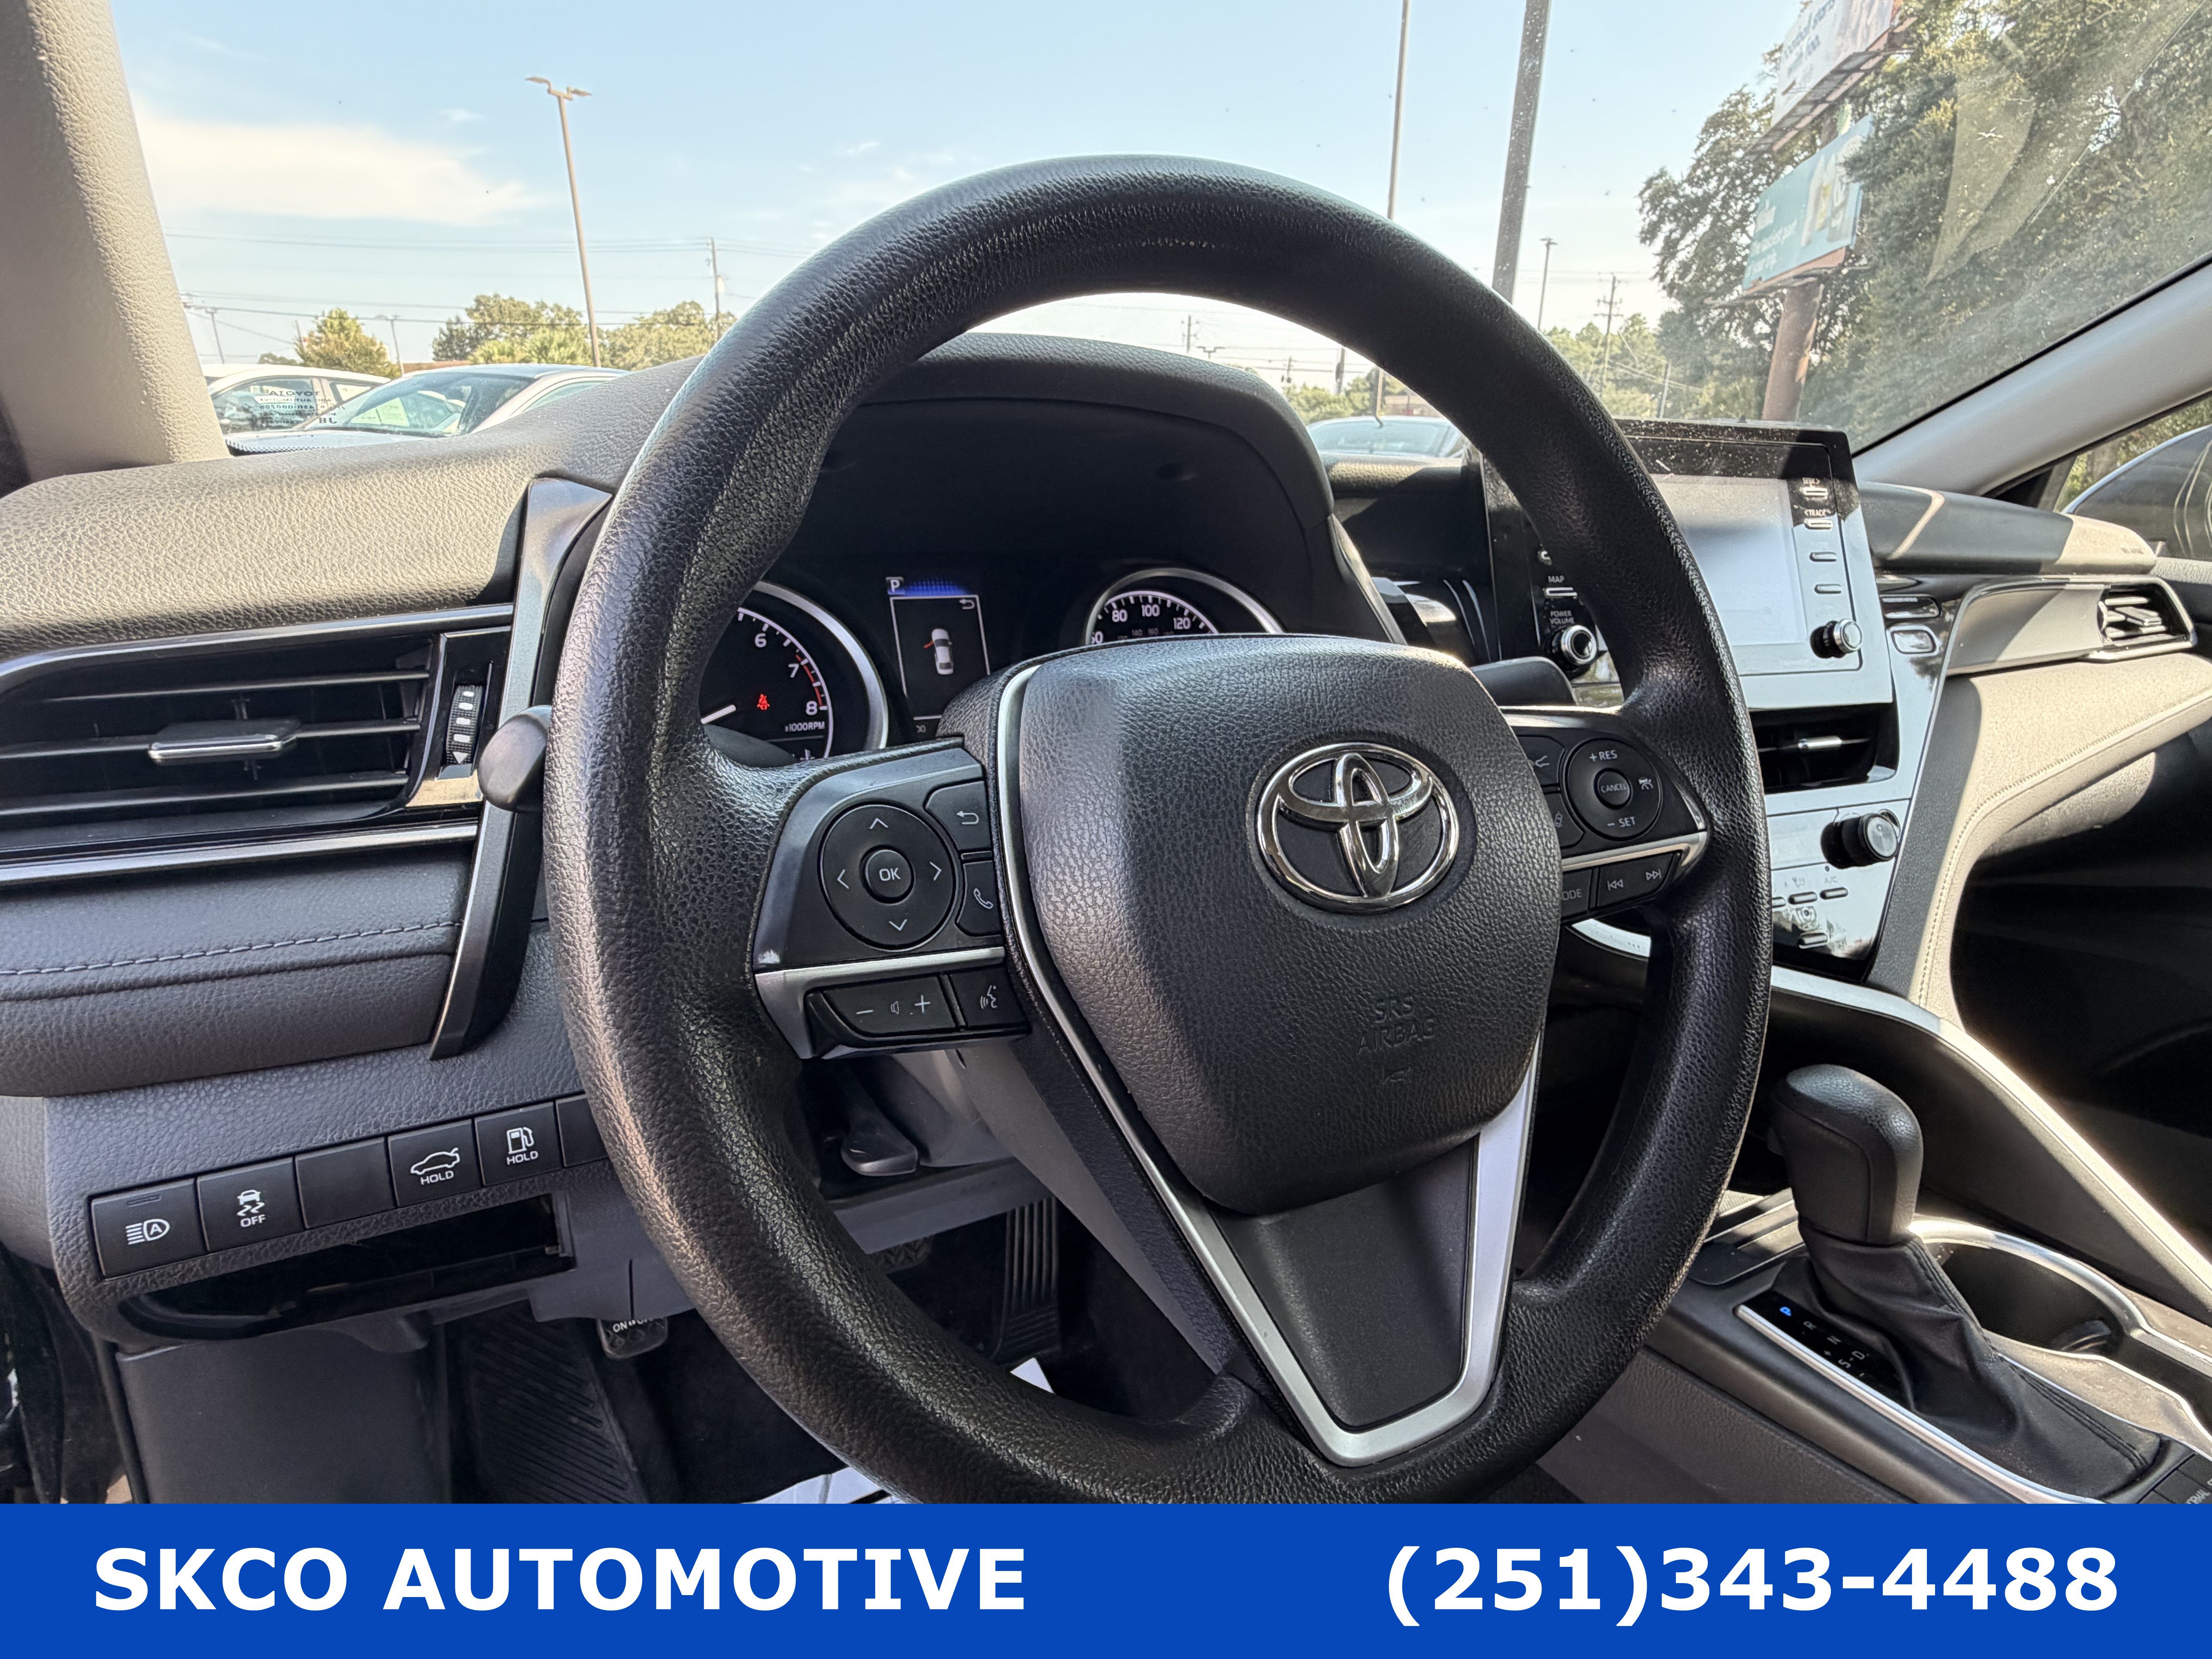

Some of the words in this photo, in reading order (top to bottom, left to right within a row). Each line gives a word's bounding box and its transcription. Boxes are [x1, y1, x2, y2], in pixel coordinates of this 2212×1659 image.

[890, 579, 900, 593] P
[1112, 610, 1128, 622] 80
[1142, 604, 1160, 617] 100
[1173, 618, 1191, 630] 120
[755, 633, 767, 647] 6
[788, 663, 799, 678] 7
[805, 701, 817, 715] 8
[1600, 783, 1626, 793] CANCEL
[879, 867, 901, 881] OK
[1824, 876, 1838, 884] A/C
[1561, 889, 1582, 901] ODE
[1374, 997, 1414, 1024] SRS
[1355, 1018, 1435, 1054] AIRBAG
[507, 1150, 539, 1166] HOLD
[420, 1170, 454, 1185] HOLD
[240, 1214, 266, 1228] OFF
[613, 1321, 628, 1333] ON
[1803, 1321, 1817, 1330] R
[1826, 1336, 1841, 1345] N
[1838, 1358, 1851, 1369] S
